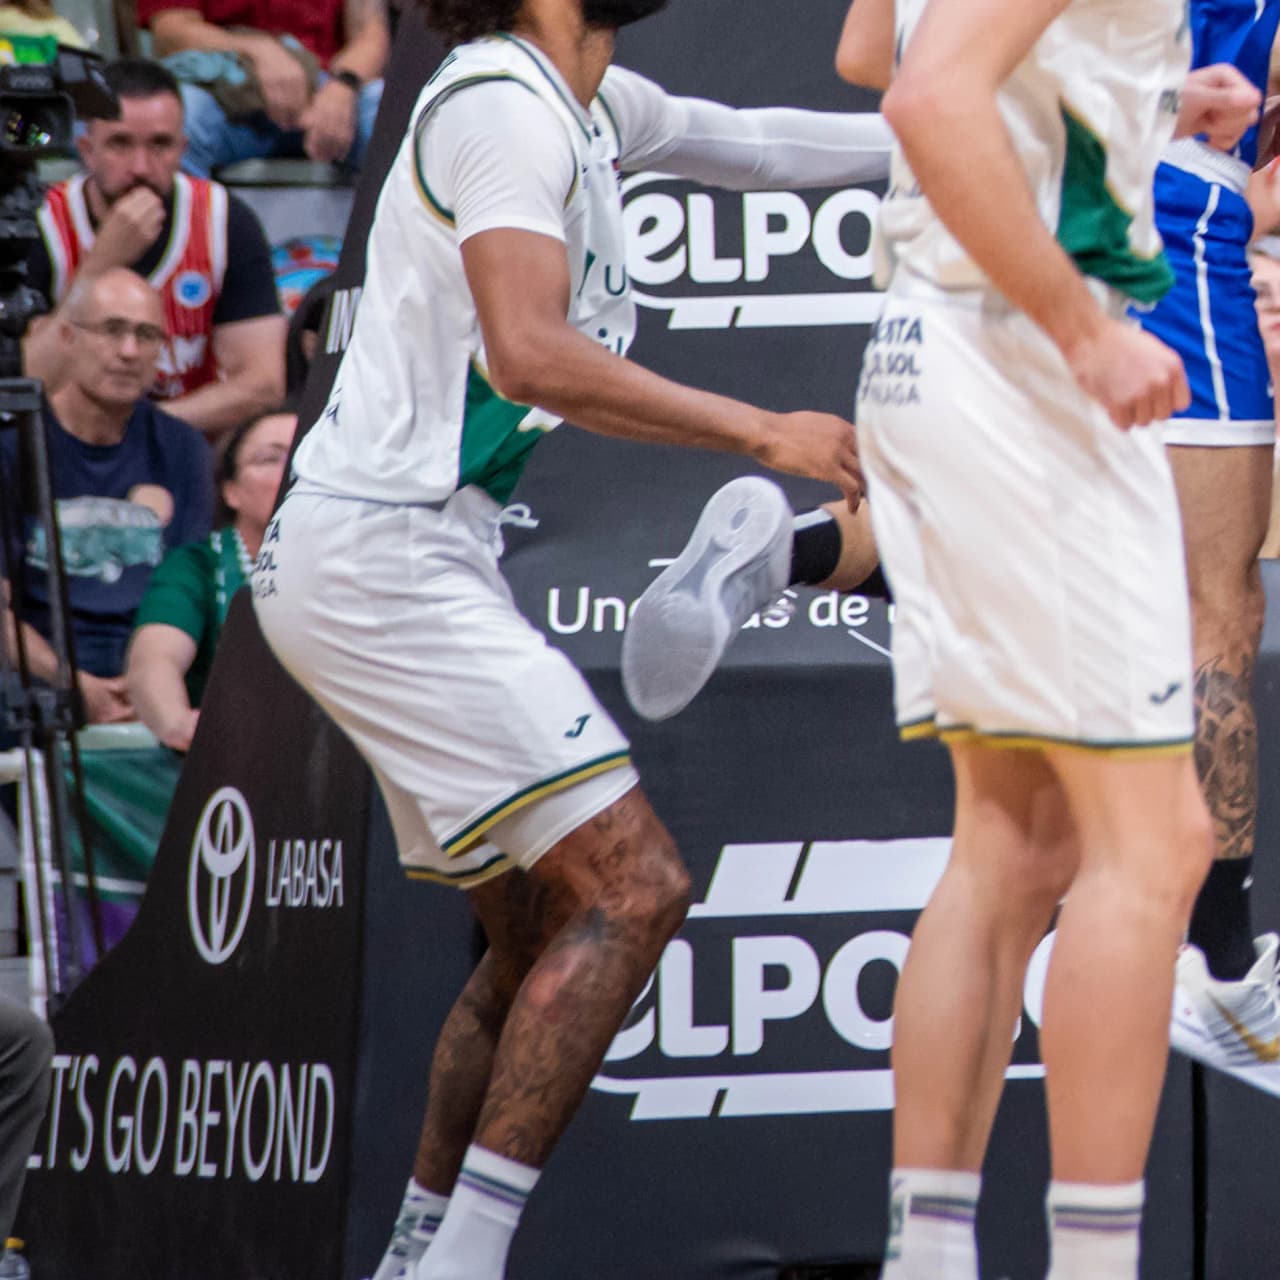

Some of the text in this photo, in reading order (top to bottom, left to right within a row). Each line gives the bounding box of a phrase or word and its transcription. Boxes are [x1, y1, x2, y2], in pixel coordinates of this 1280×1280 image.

[808, 591, 869, 627] de
[265, 838, 344, 908] LABASA
[104, 1055, 169, 1175] GO
[174, 1059, 335, 1184] BEYOND
